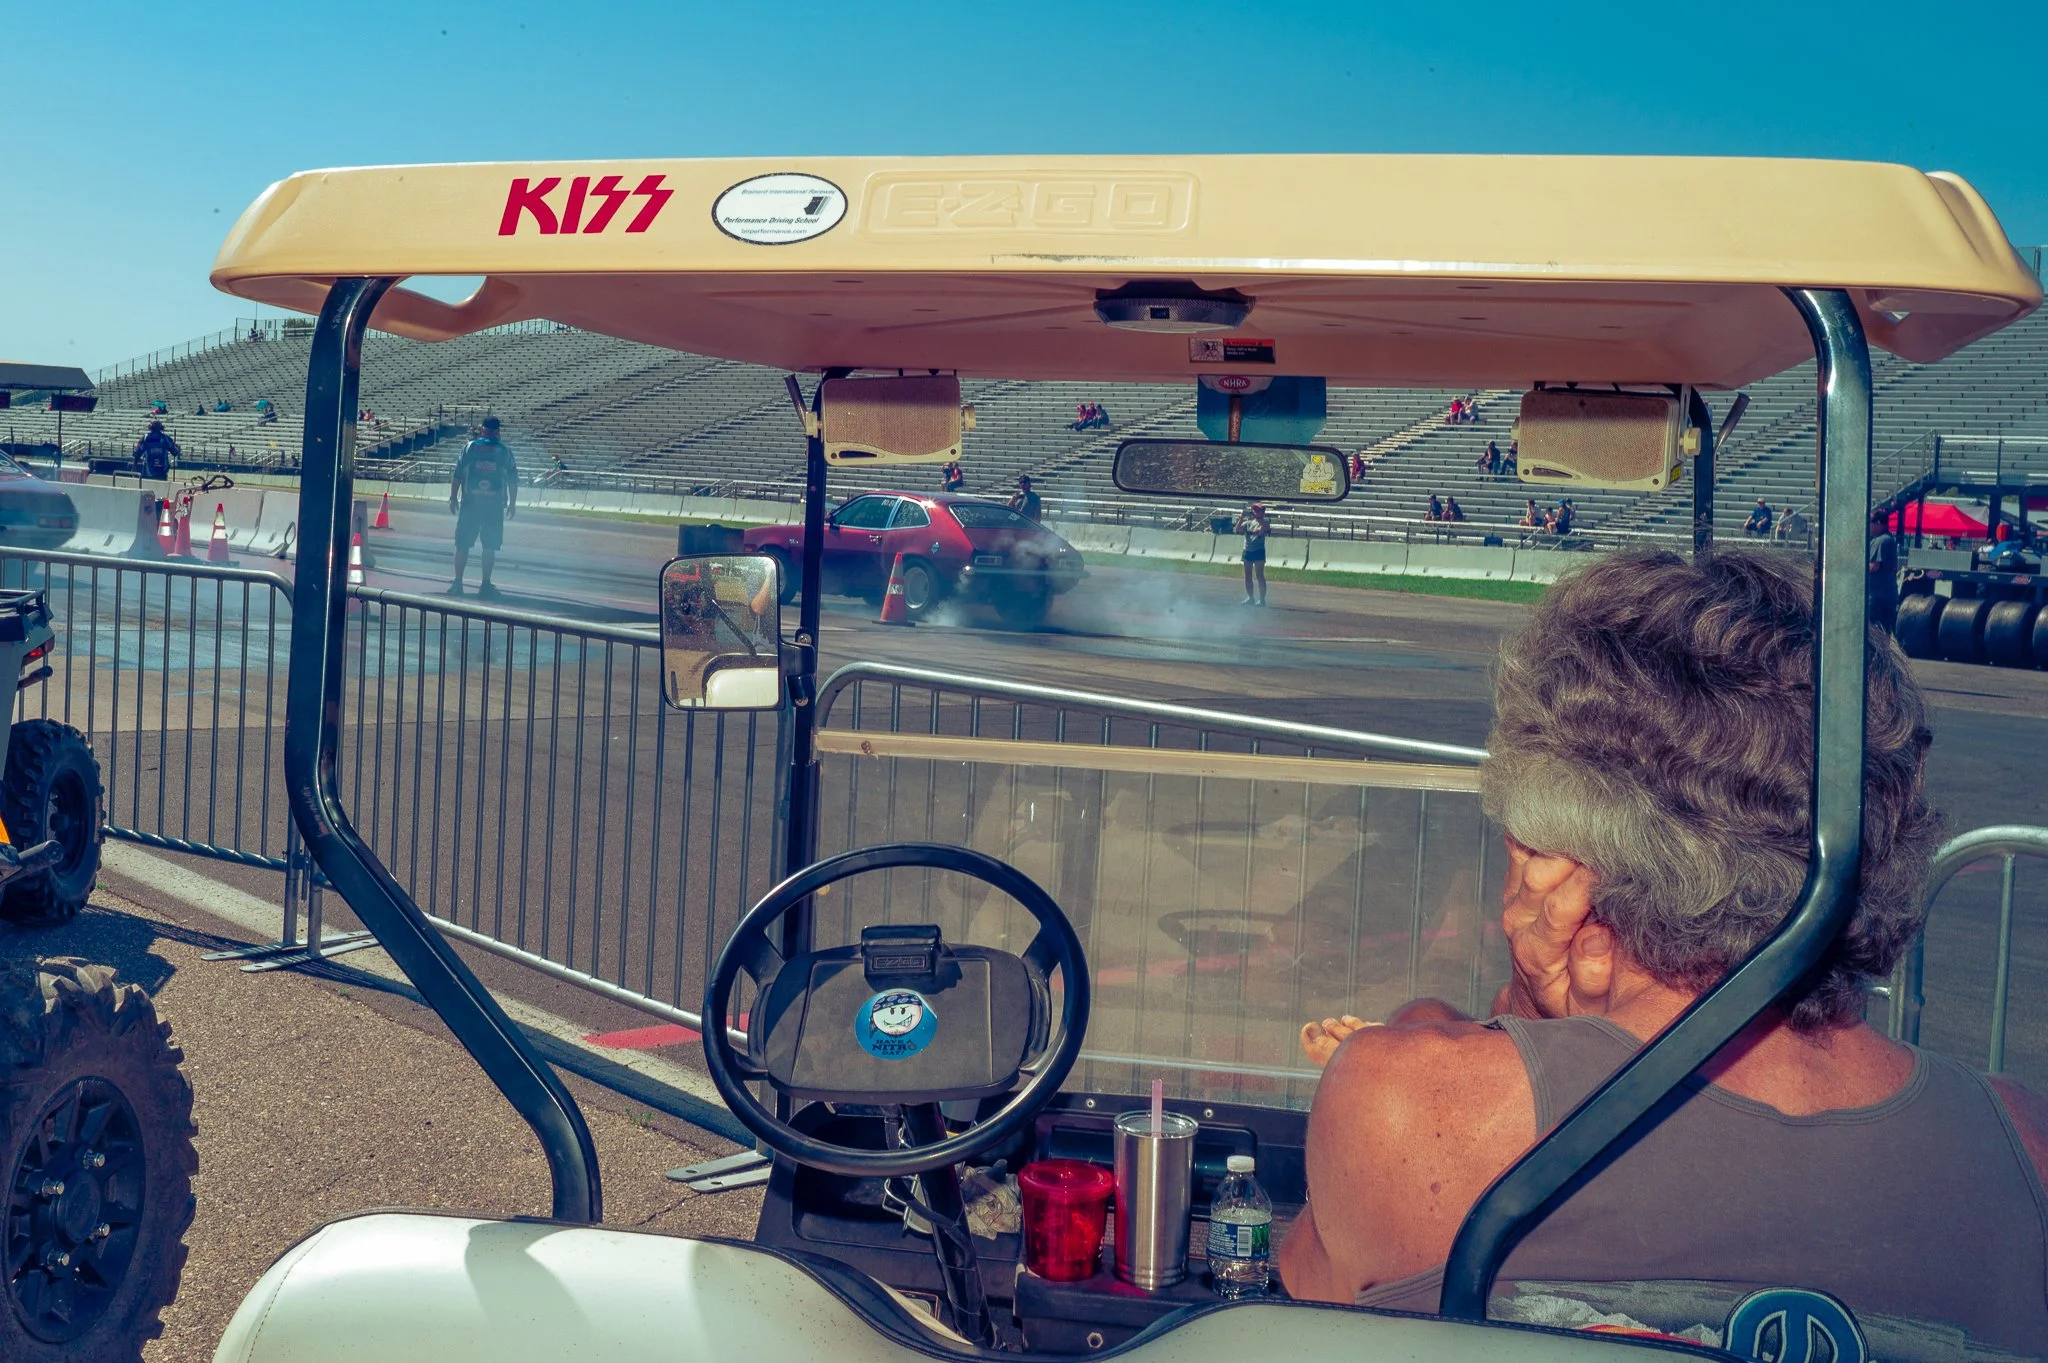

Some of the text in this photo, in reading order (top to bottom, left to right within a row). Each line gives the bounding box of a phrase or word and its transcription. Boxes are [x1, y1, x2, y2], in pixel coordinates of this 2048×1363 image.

[498, 174, 674, 235] KISS
[768, 217, 794, 225] Driving
[1223, 378, 1248, 388] NHRA
